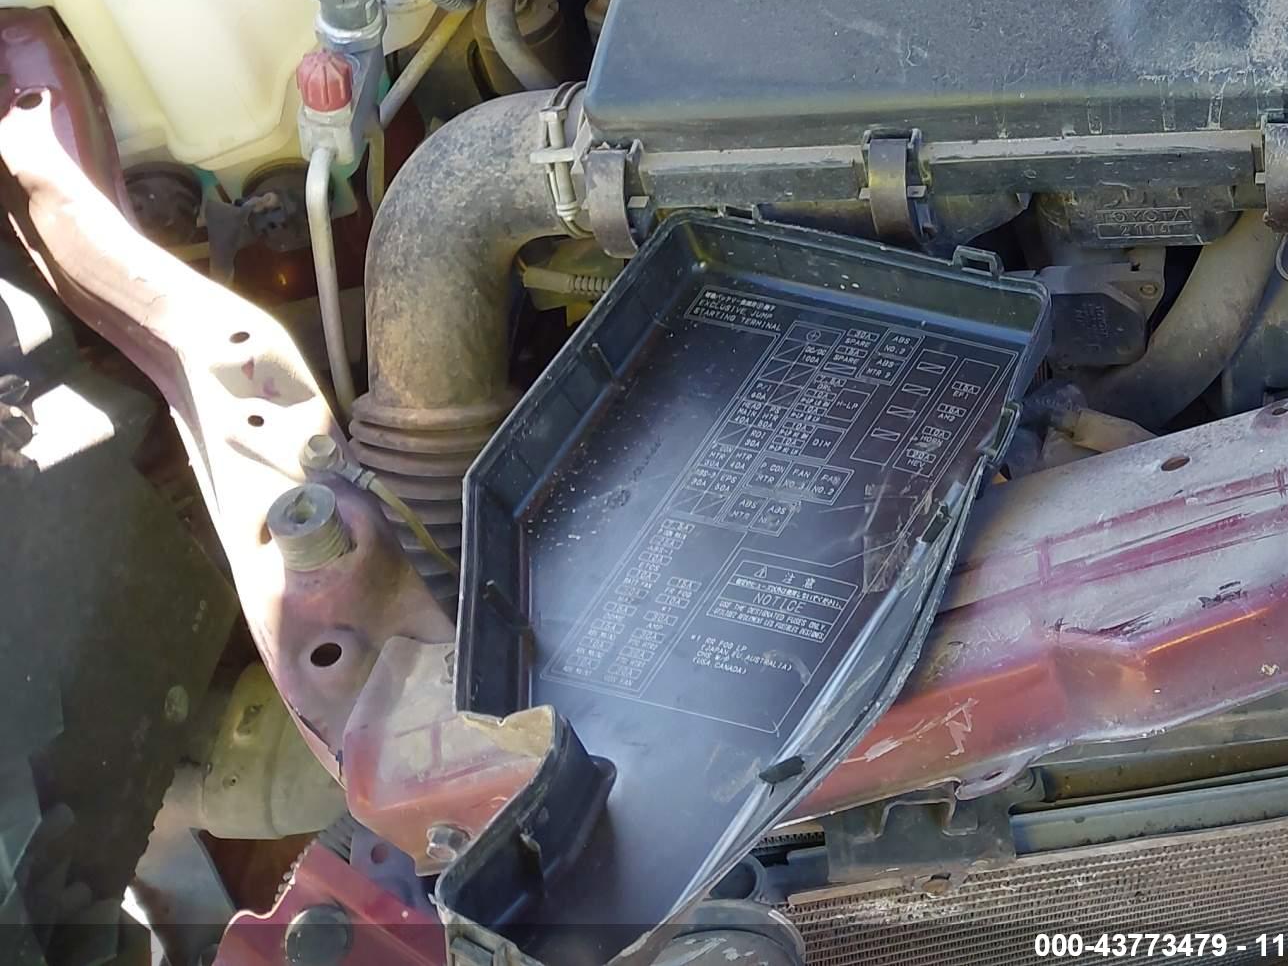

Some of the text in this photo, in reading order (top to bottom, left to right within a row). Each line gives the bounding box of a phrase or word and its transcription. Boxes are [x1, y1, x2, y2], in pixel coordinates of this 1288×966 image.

[1101, 208, 1191, 223] TOYOTA
[698, 299, 748, 315] EXCLUSIVE
[750, 310, 774, 320] JUMP
[693, 307, 782, 332] STARTING TERMINAL
[844, 338, 871, 348] SPARE
[892, 337, 911, 346] ABS
[832, 353, 860, 365] SPARE
[876, 359, 895, 369] ABS
[752, 592, 807, 614] NOTICE
